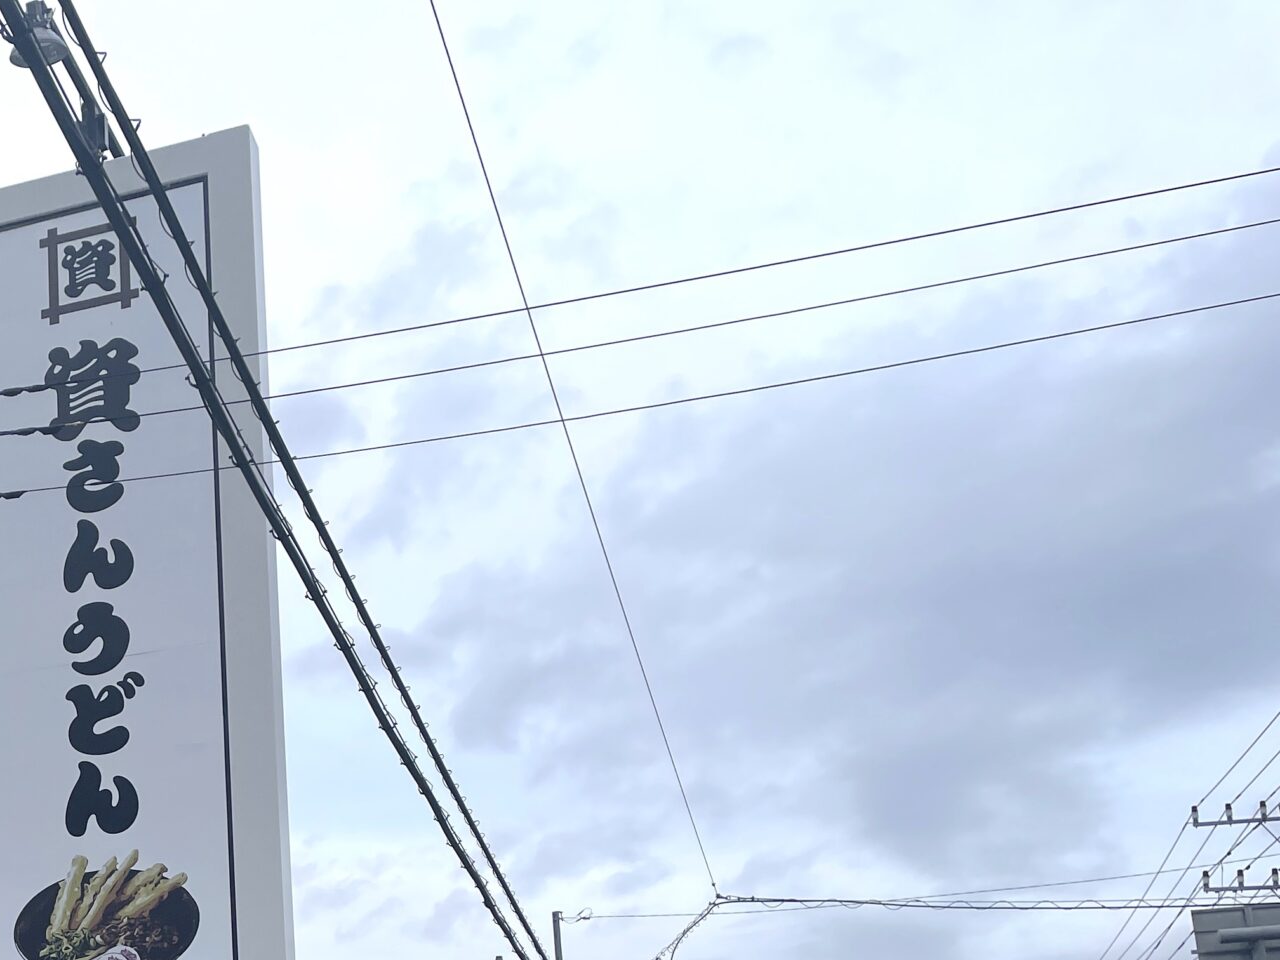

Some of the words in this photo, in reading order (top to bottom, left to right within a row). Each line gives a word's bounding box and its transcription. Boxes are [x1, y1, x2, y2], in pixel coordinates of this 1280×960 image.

[43, 337, 146, 837] 資さんうどん
